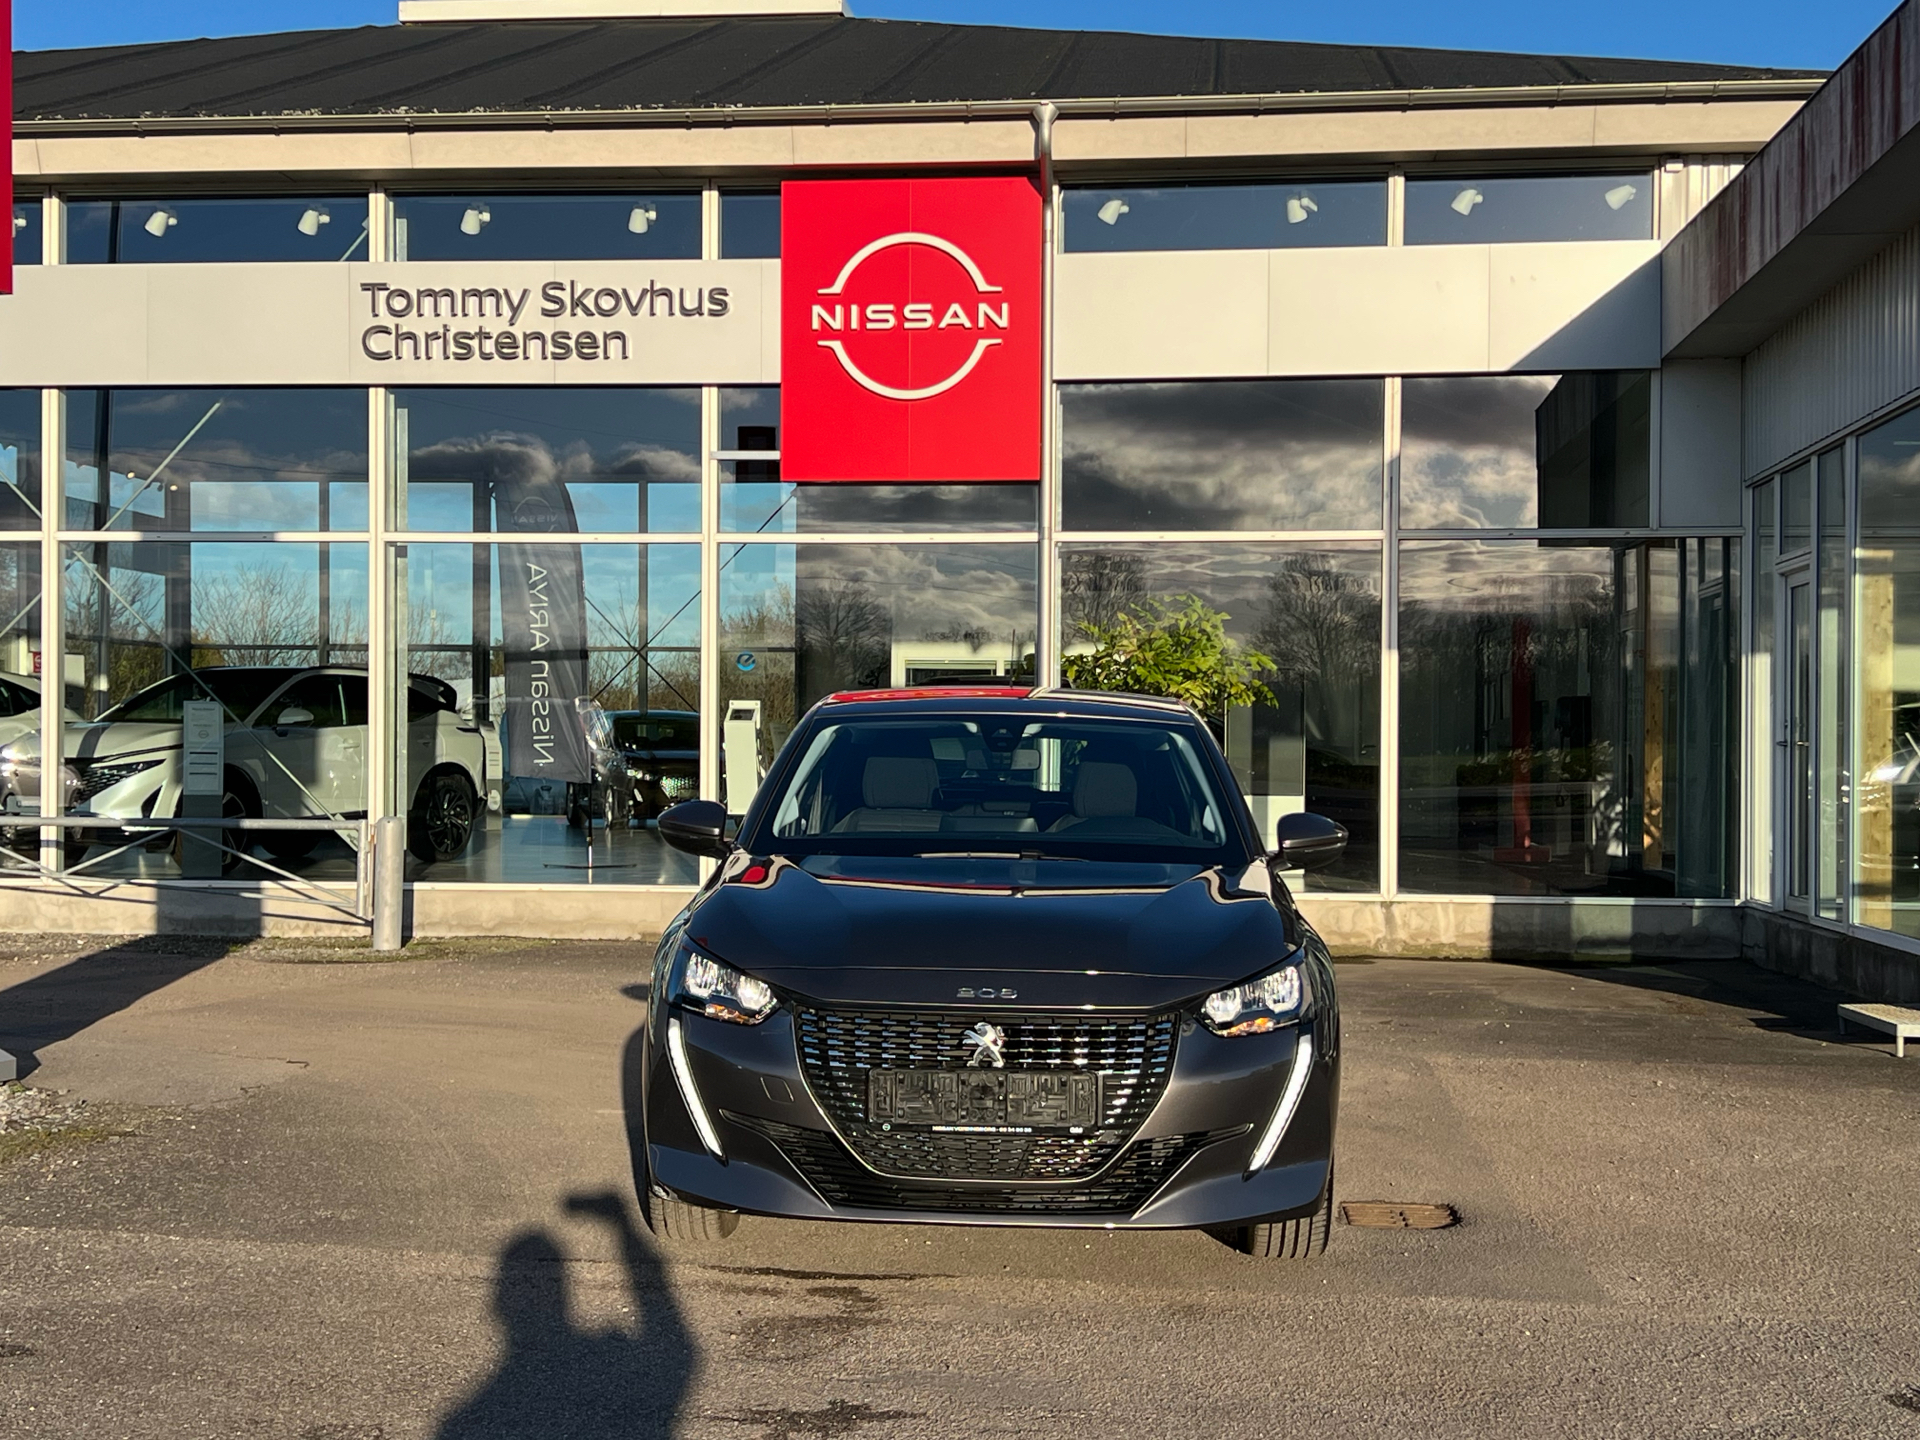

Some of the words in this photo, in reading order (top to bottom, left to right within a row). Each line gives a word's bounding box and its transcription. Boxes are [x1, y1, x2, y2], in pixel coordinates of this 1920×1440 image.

[360, 282, 531, 326] Tommy
[540, 280, 730, 317] Skovhus
[811, 302, 1009, 331] NISSAN
[361, 323, 631, 360] Christensen
